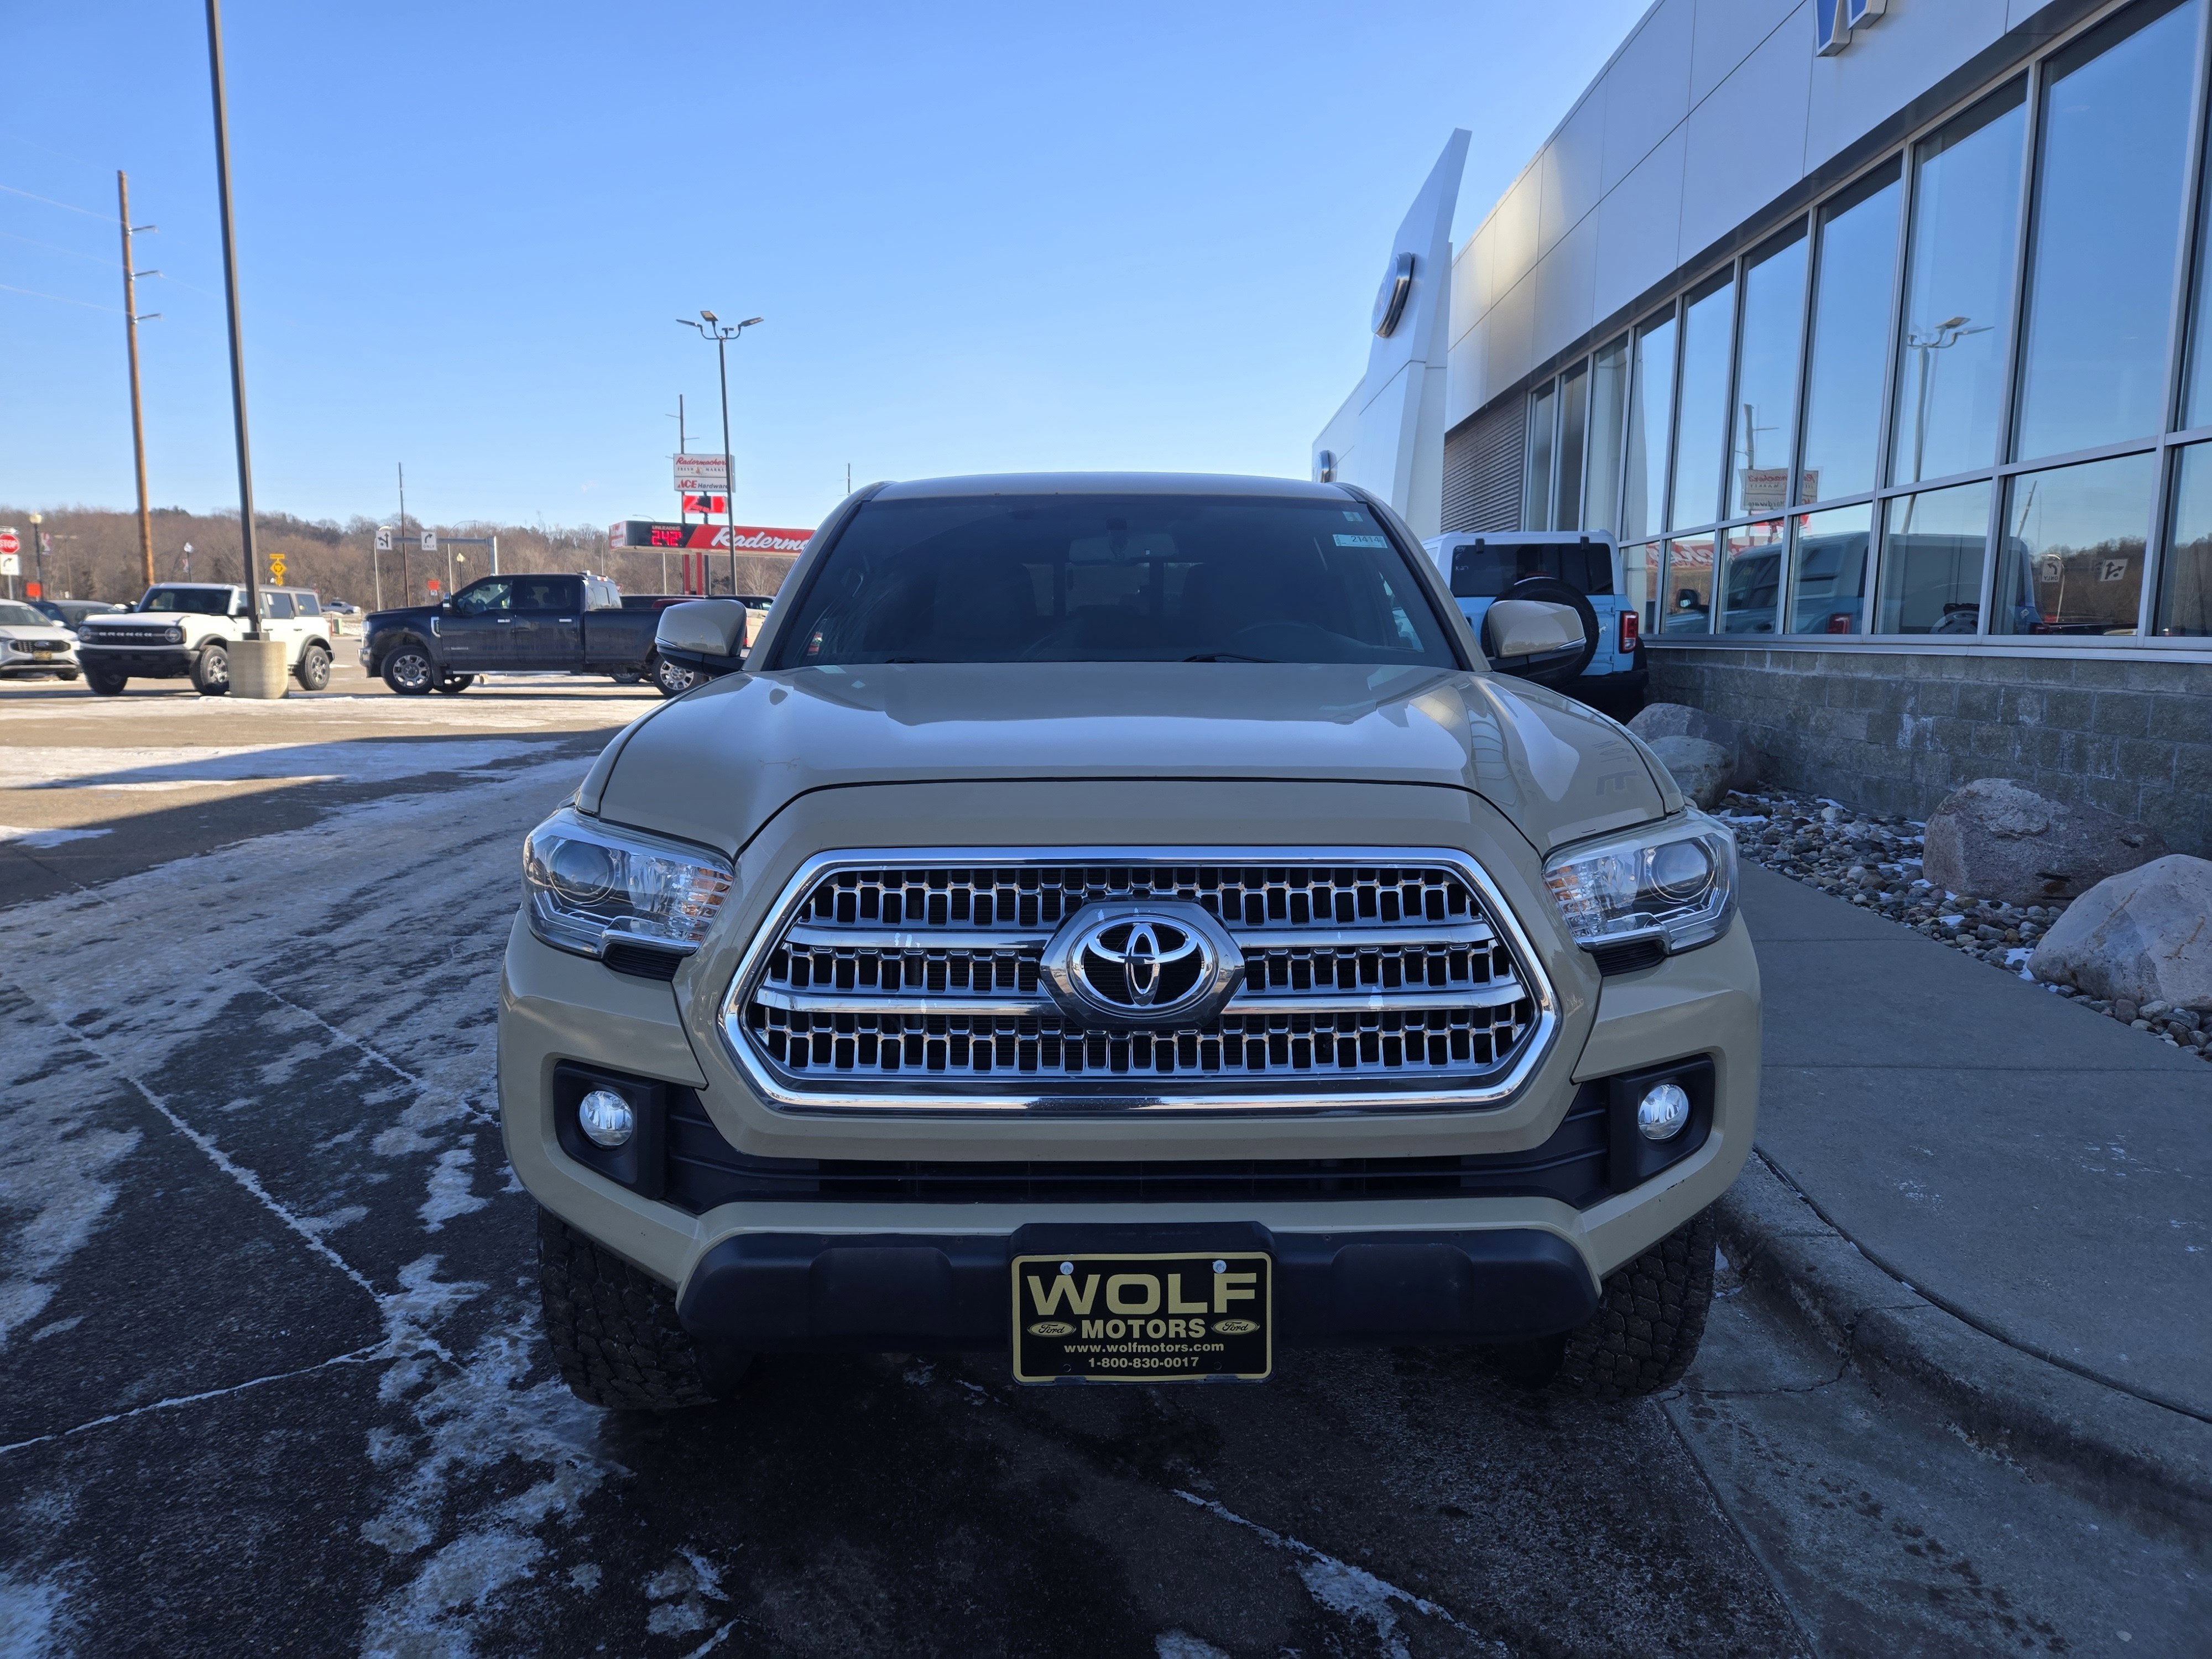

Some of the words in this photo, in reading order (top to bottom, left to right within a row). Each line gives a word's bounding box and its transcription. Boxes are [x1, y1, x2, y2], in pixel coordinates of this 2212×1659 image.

[676, 457, 726, 466] Radermacher
[677, 479, 697, 488] ACE
[1027, 1272, 1256, 1315] WOLF
[1038, 1324, 1065, 1334] Ford
[1082, 1319, 1205, 1339] MOTORS
[1222, 1322, 1248, 1332] Ford
[1064, 1342, 1224, 1353] www.wolfmotors.com
[1088, 1357, 1199, 1368] 1-800-830-0017
